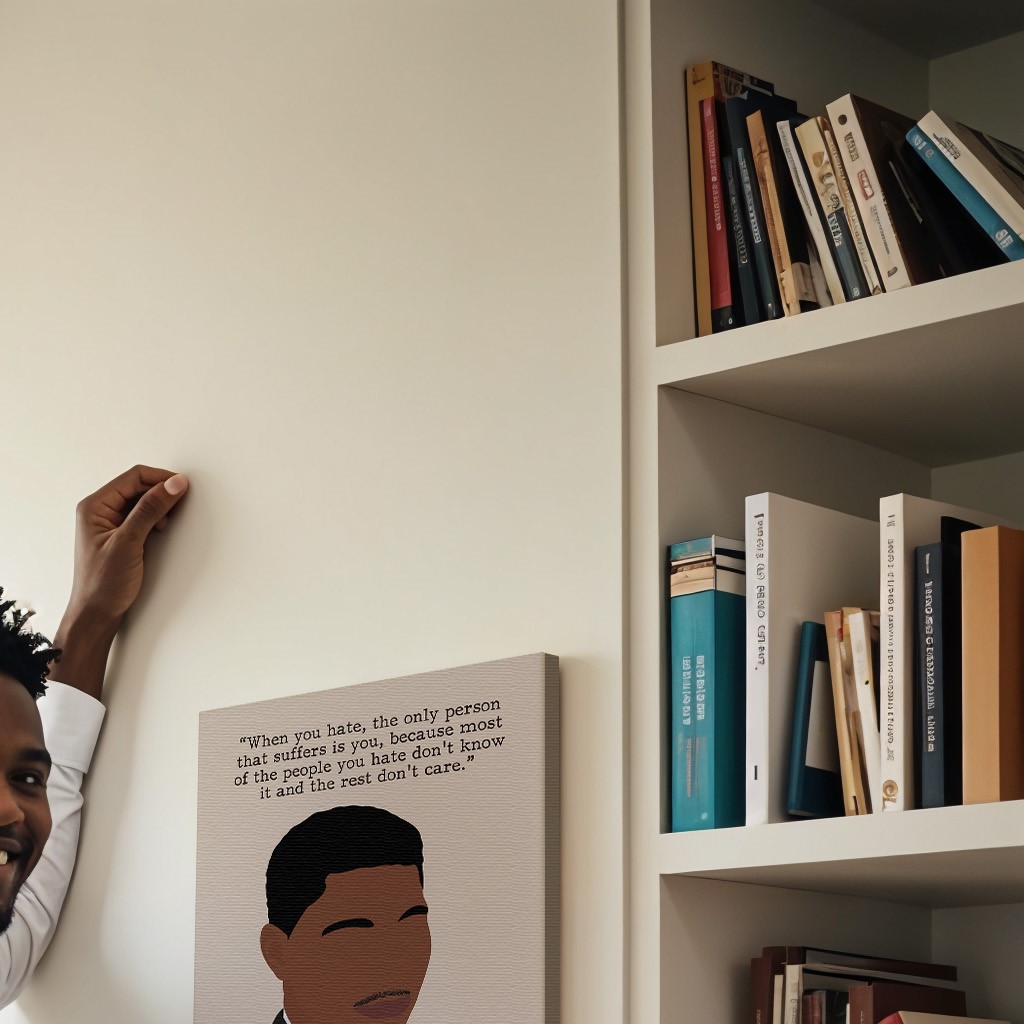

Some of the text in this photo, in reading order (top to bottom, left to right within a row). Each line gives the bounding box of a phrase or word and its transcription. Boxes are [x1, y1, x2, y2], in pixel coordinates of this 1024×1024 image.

[236, 715, 504, 769] that suffers is you, because most
[239, 699, 502, 750] “When you hate, the only person
[234, 736, 506, 787] of the people you hate don't know
[259, 754, 475, 800] it and the rest don't care.”
